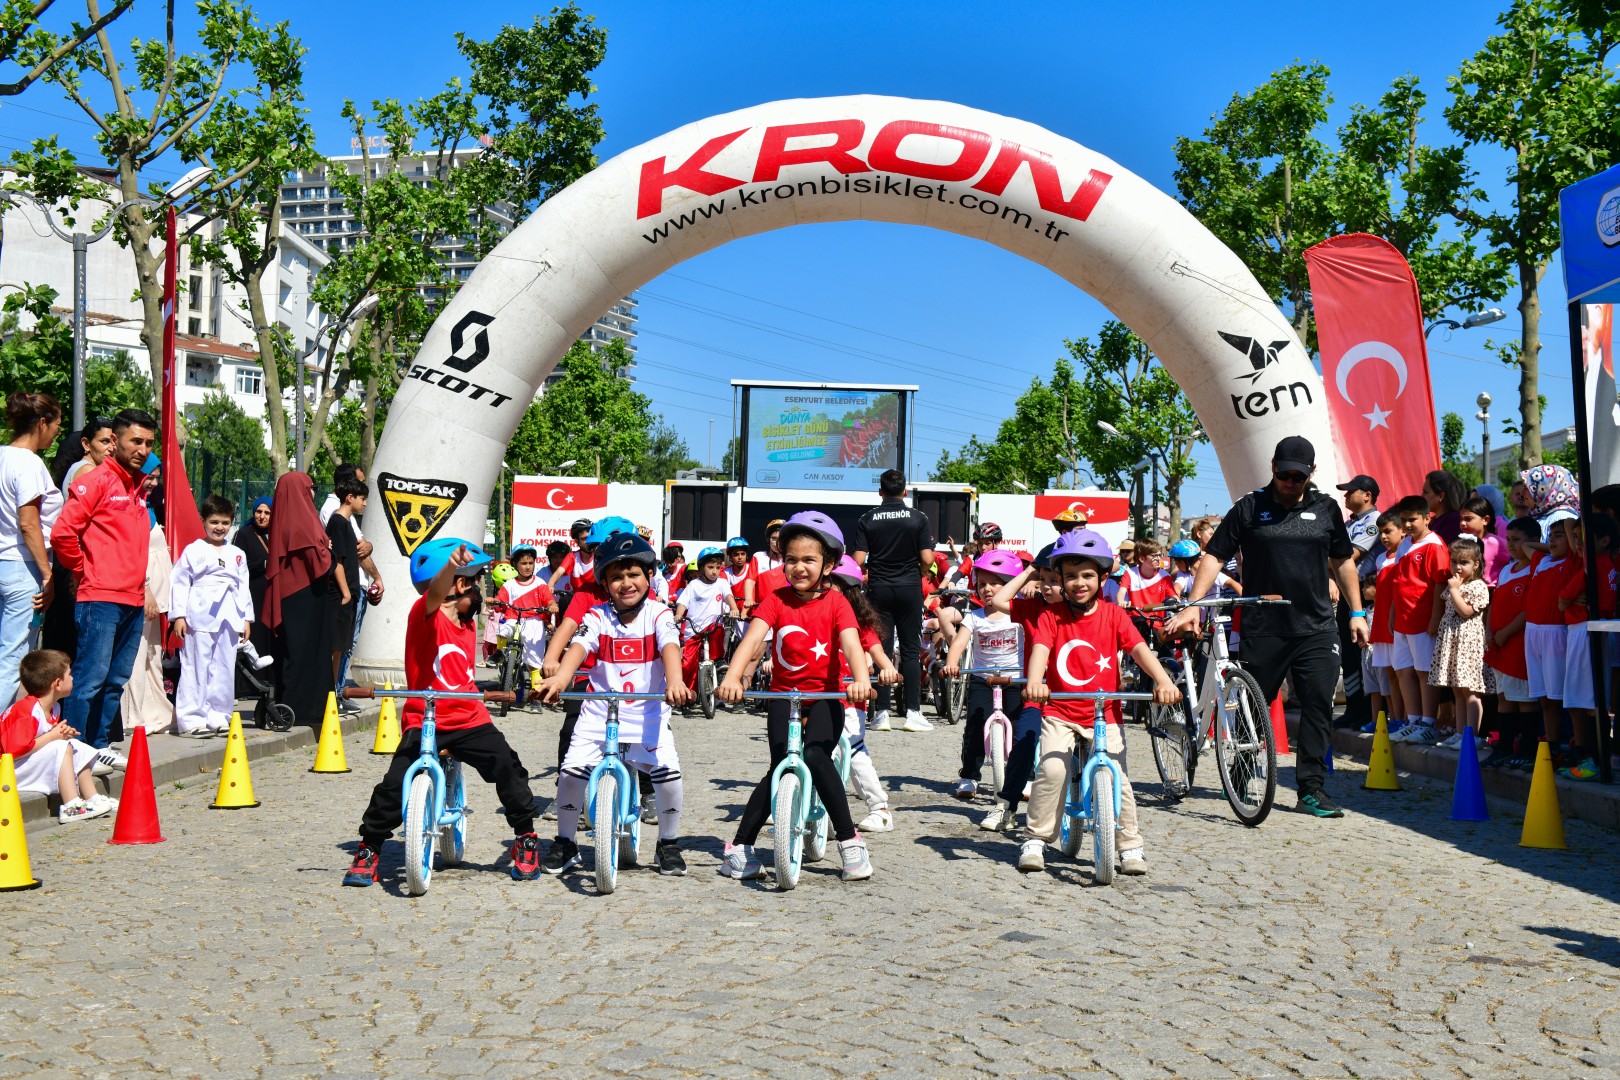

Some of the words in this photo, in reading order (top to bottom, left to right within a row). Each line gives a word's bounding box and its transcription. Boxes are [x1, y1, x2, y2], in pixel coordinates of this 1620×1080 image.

[637, 119, 1113, 222] KRON
[642, 174, 1069, 244] www.kronbisiklet.com.tr
[407, 364, 512, 408] SCOTT
[784, 396, 823, 404] ESENYURT
[825, 396, 868, 405] BELEDİYESİ
[1230, 381, 1313, 420] tern
[780, 412, 811, 425] DÜNYA
[762, 424, 802, 438] BİSİKLET
[804, 420, 829, 434] GÜNÜ
[821, 473, 845, 481] AKSOY
[385, 478, 456, 498] TOPEAK
[872, 509, 911, 521] ANTRENÖR
[535, 528, 573, 537] KIYMET
